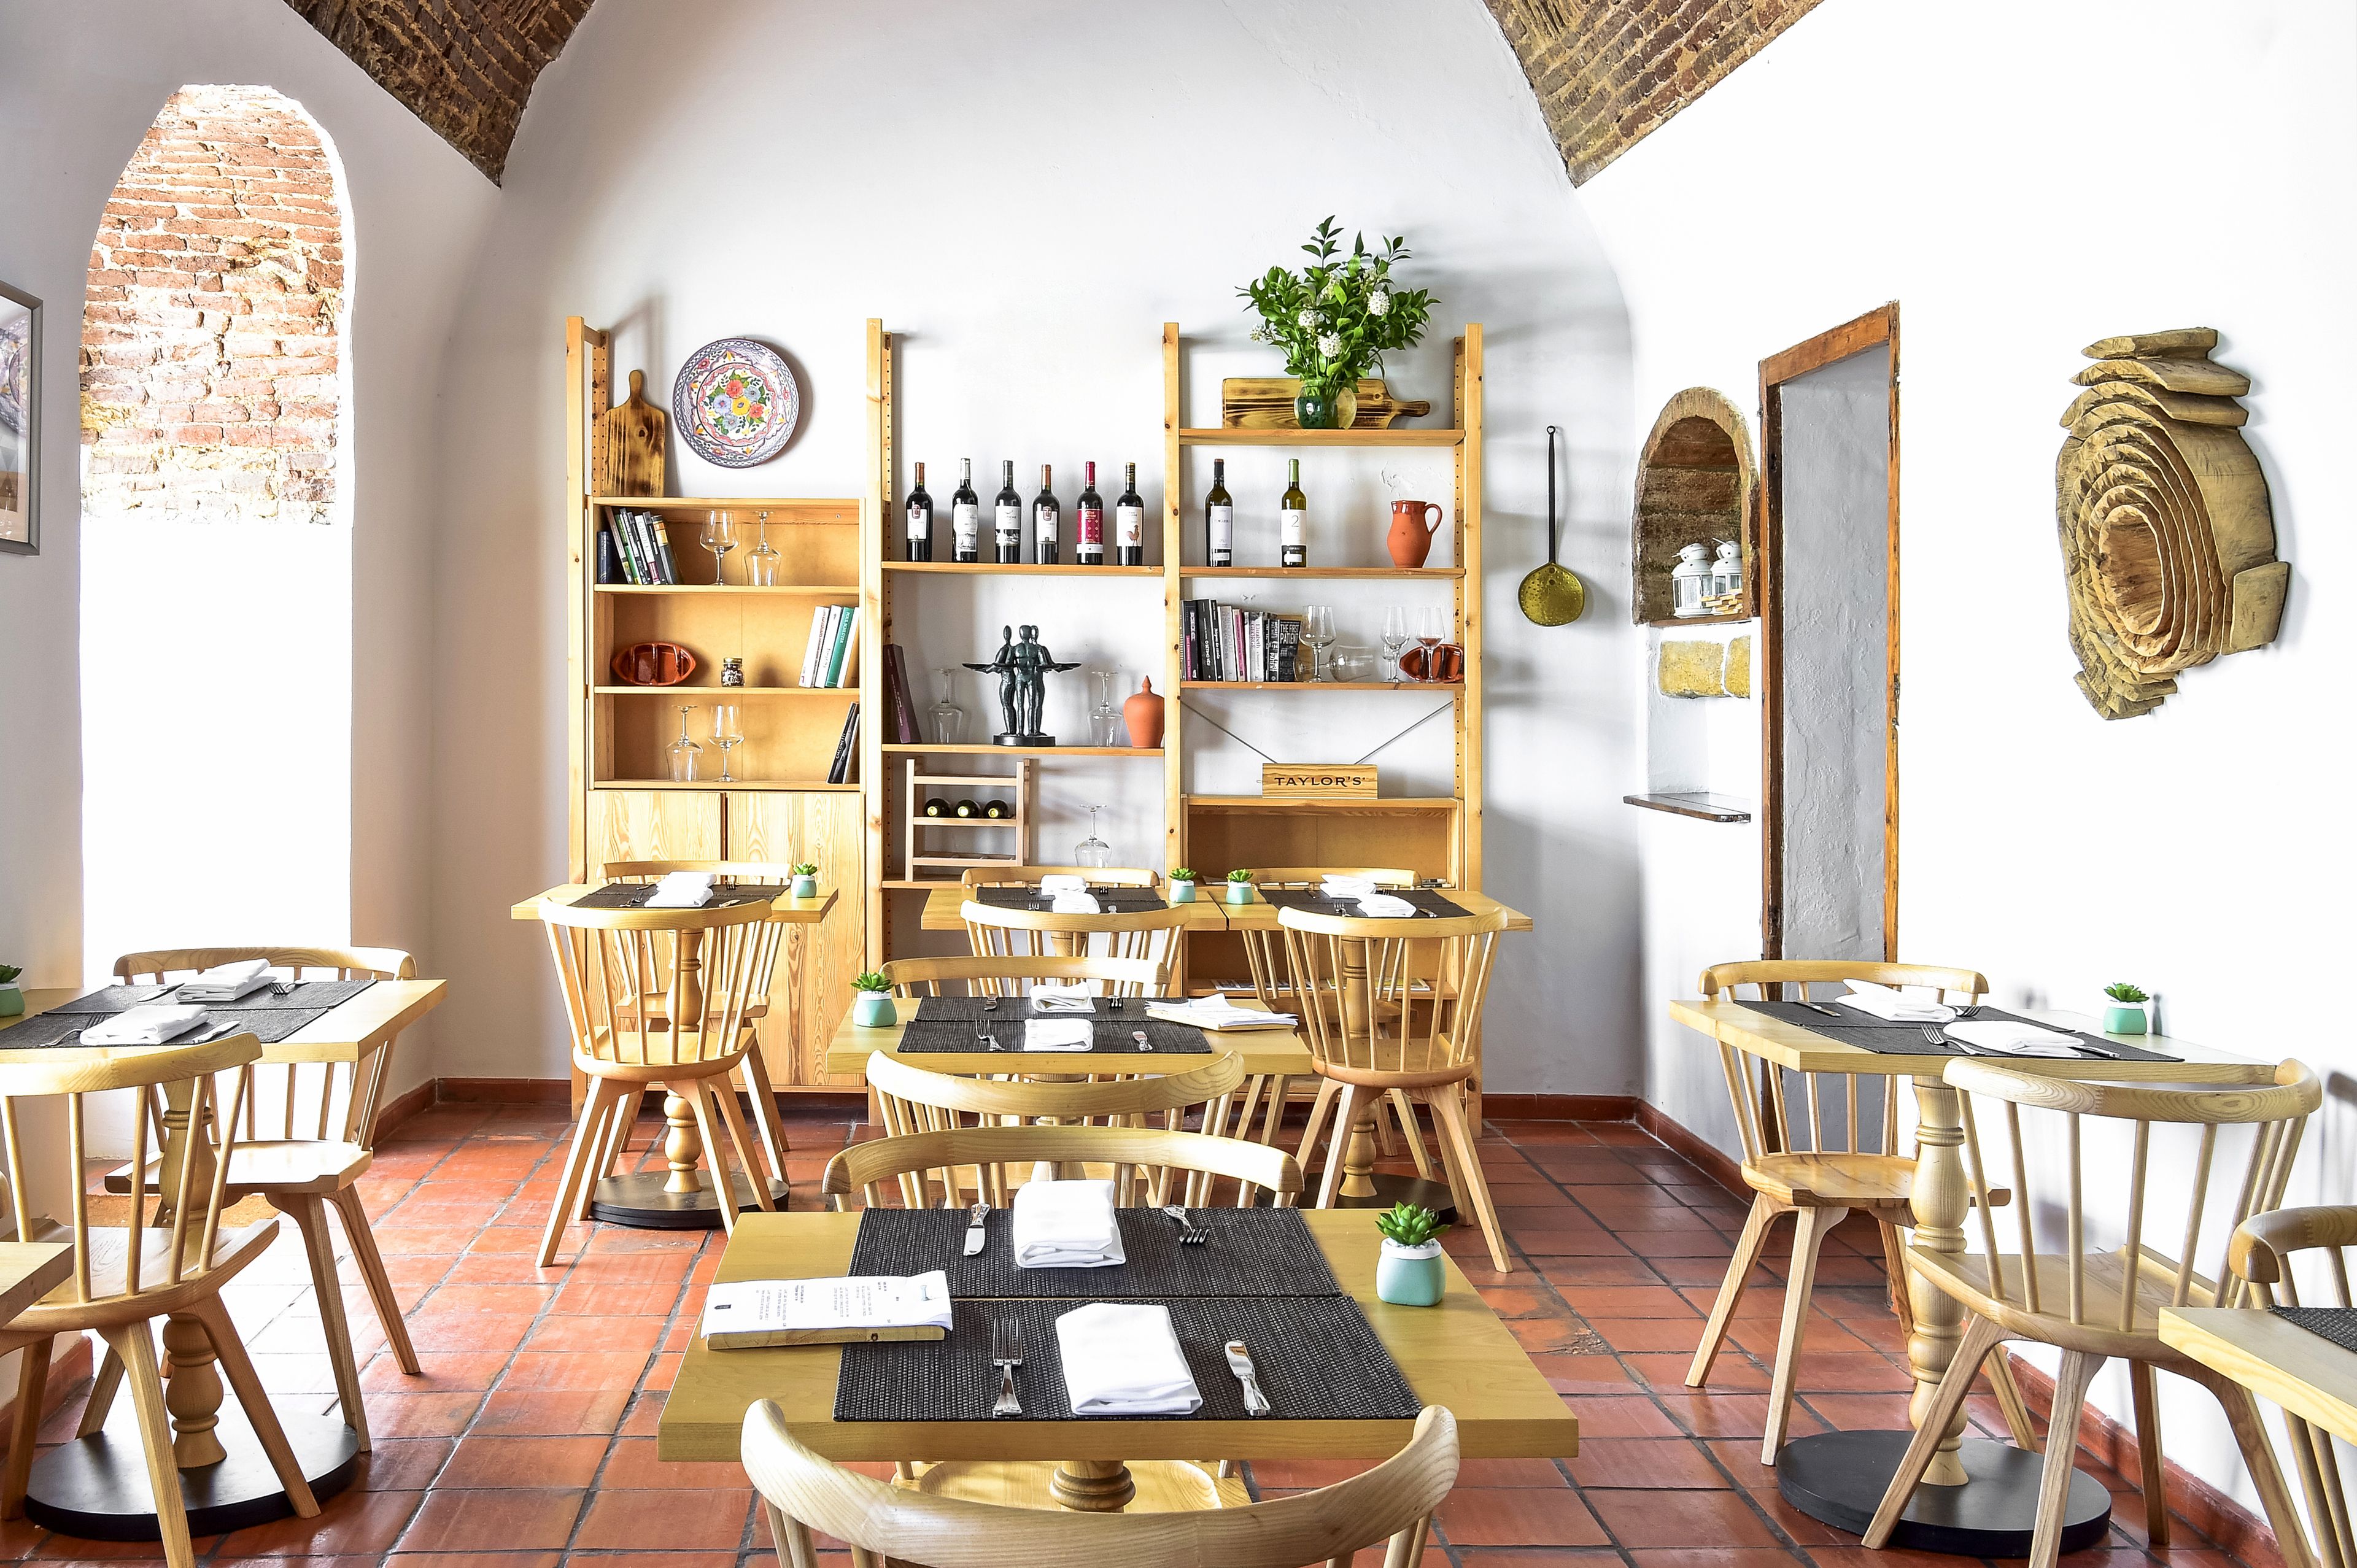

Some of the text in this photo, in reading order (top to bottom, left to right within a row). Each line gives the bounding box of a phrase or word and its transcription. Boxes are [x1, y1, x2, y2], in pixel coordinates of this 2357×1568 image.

[1291, 515, 1299, 528] 2
[1280, 624, 1299, 633] THE FIRST
[1280, 633, 1299, 644] PATIENT
[1274, 776, 1361, 787] TAYLOR'S
